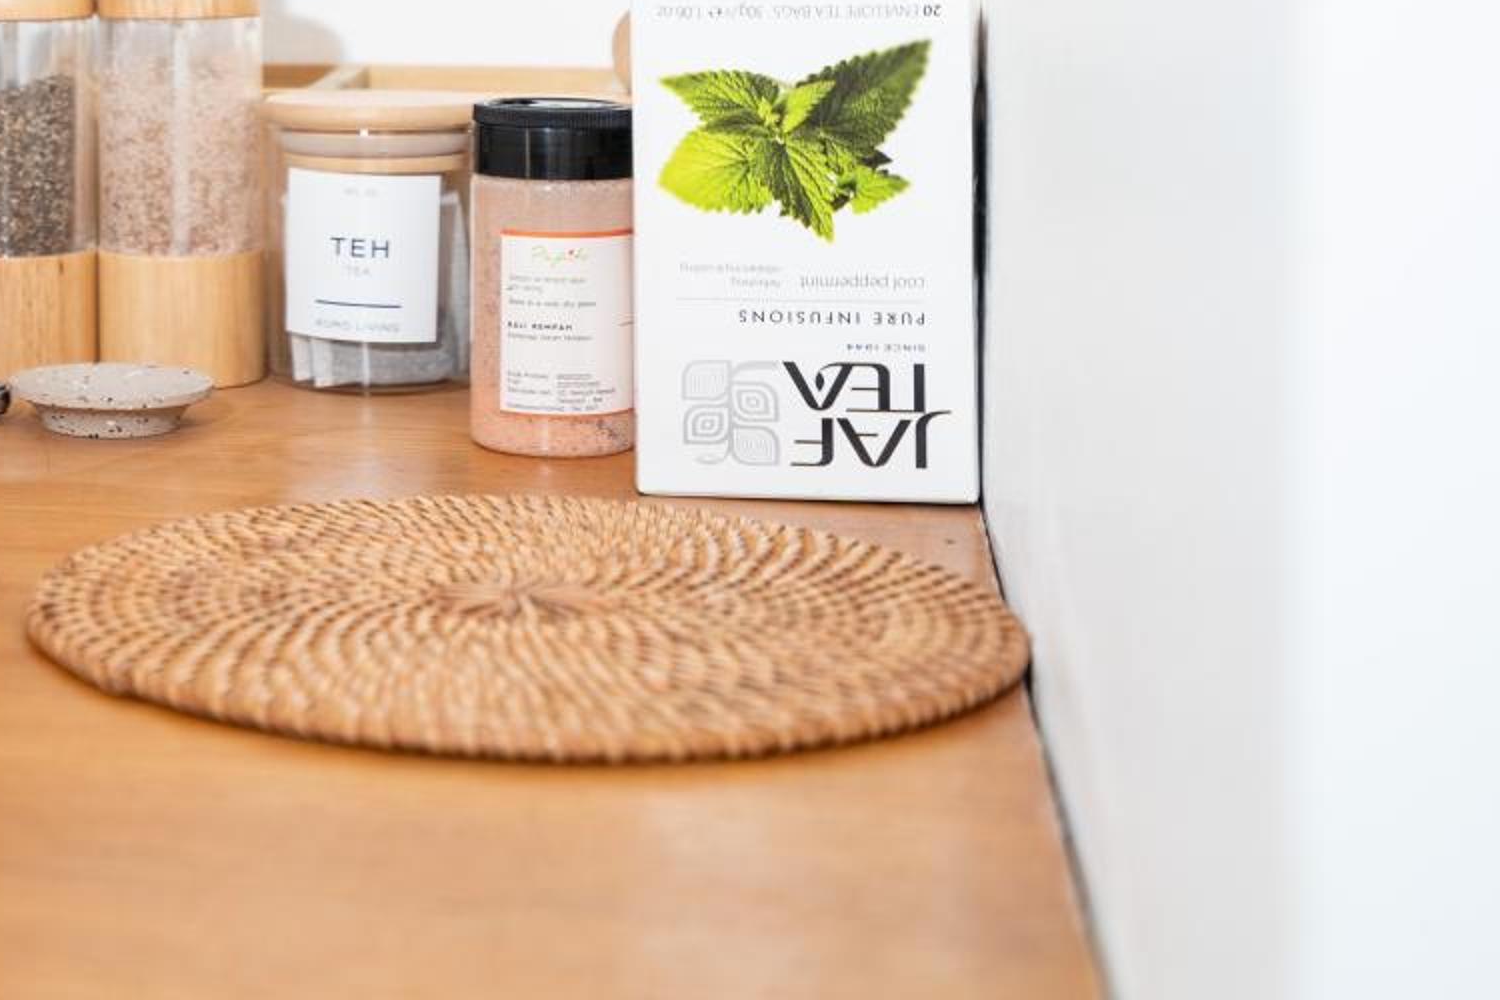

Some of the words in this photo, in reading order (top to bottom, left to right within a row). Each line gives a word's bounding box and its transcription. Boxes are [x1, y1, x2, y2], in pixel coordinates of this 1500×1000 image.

[773, 5, 810, 18] BAGS
[814, 4, 840, 18] TEA
[848, 4, 920, 18] ENVELOPE
[923, 4, 942, 17] 20
[330, 236, 390, 259] TEH
[343, 264, 371, 278] TEA
[800, 273, 890, 291] peppermint
[893, 277, 926, 291] cool
[738, 309, 861, 326] INFUSIONS
[872, 311, 926, 327] PURE
[884, 343, 926, 353] SINCE
[782, 361, 927, 414] TEA
[790, 410, 953, 470] JAF
